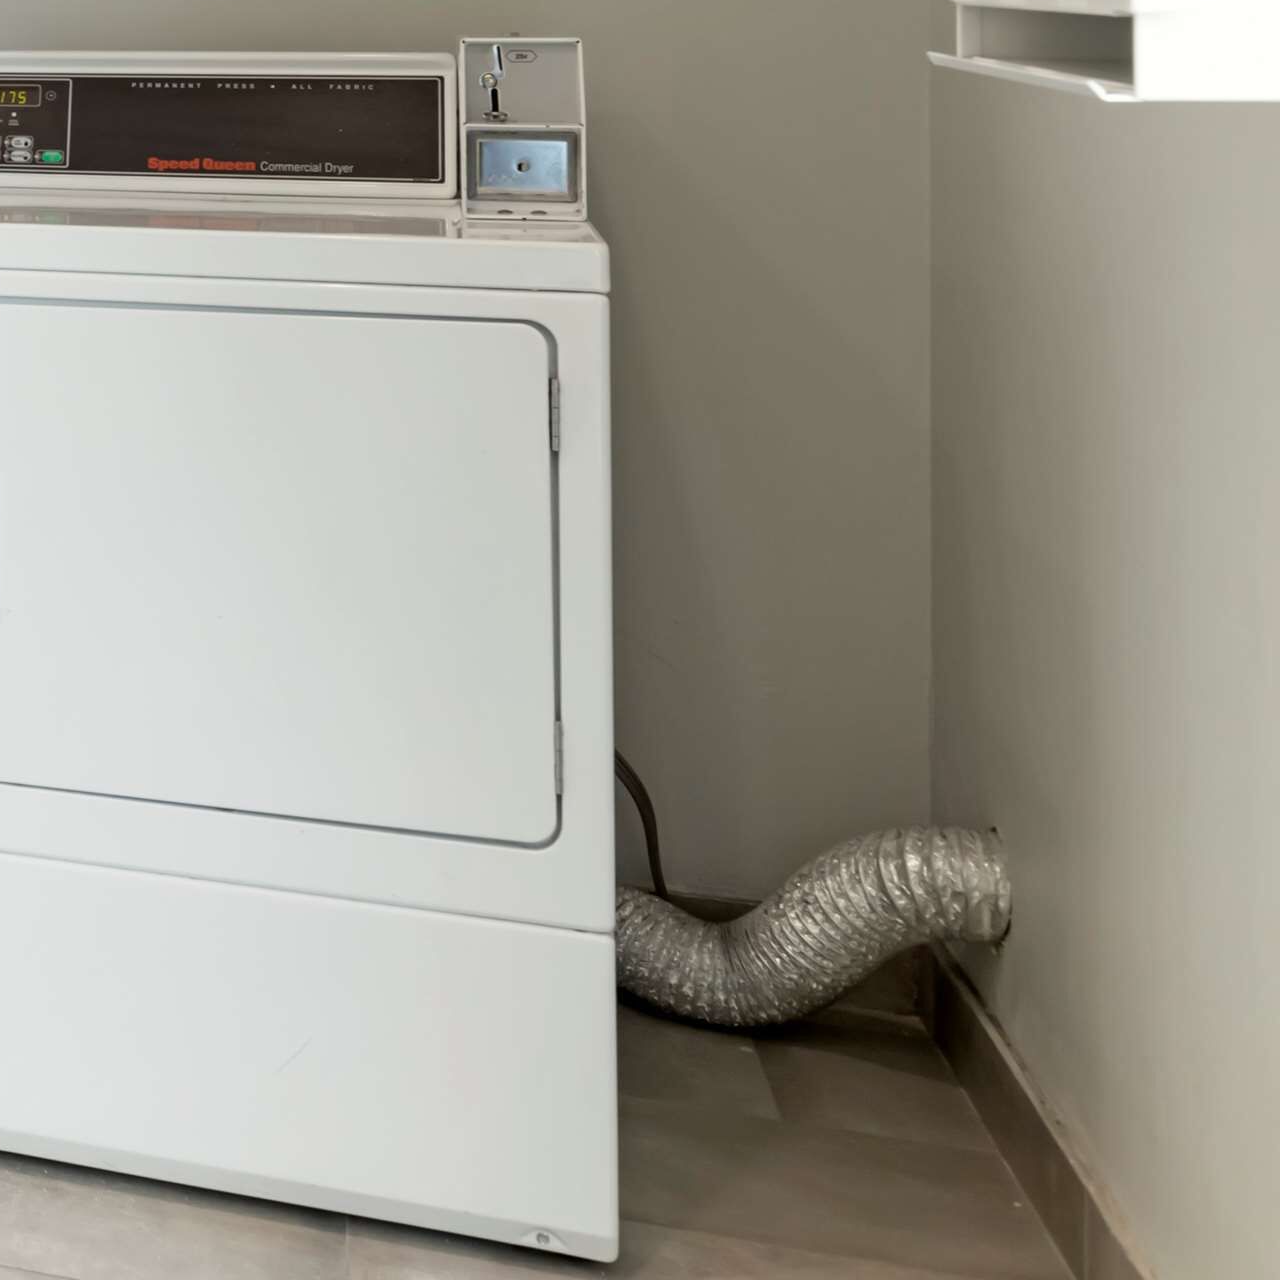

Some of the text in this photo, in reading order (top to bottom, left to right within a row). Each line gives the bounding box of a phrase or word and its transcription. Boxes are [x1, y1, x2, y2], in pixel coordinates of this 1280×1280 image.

[329, 83, 375, 91] FABRIC
[0, 91, 28, 105] 175
[147, 156, 355, 176] Speed Queen Commercial Dryer
